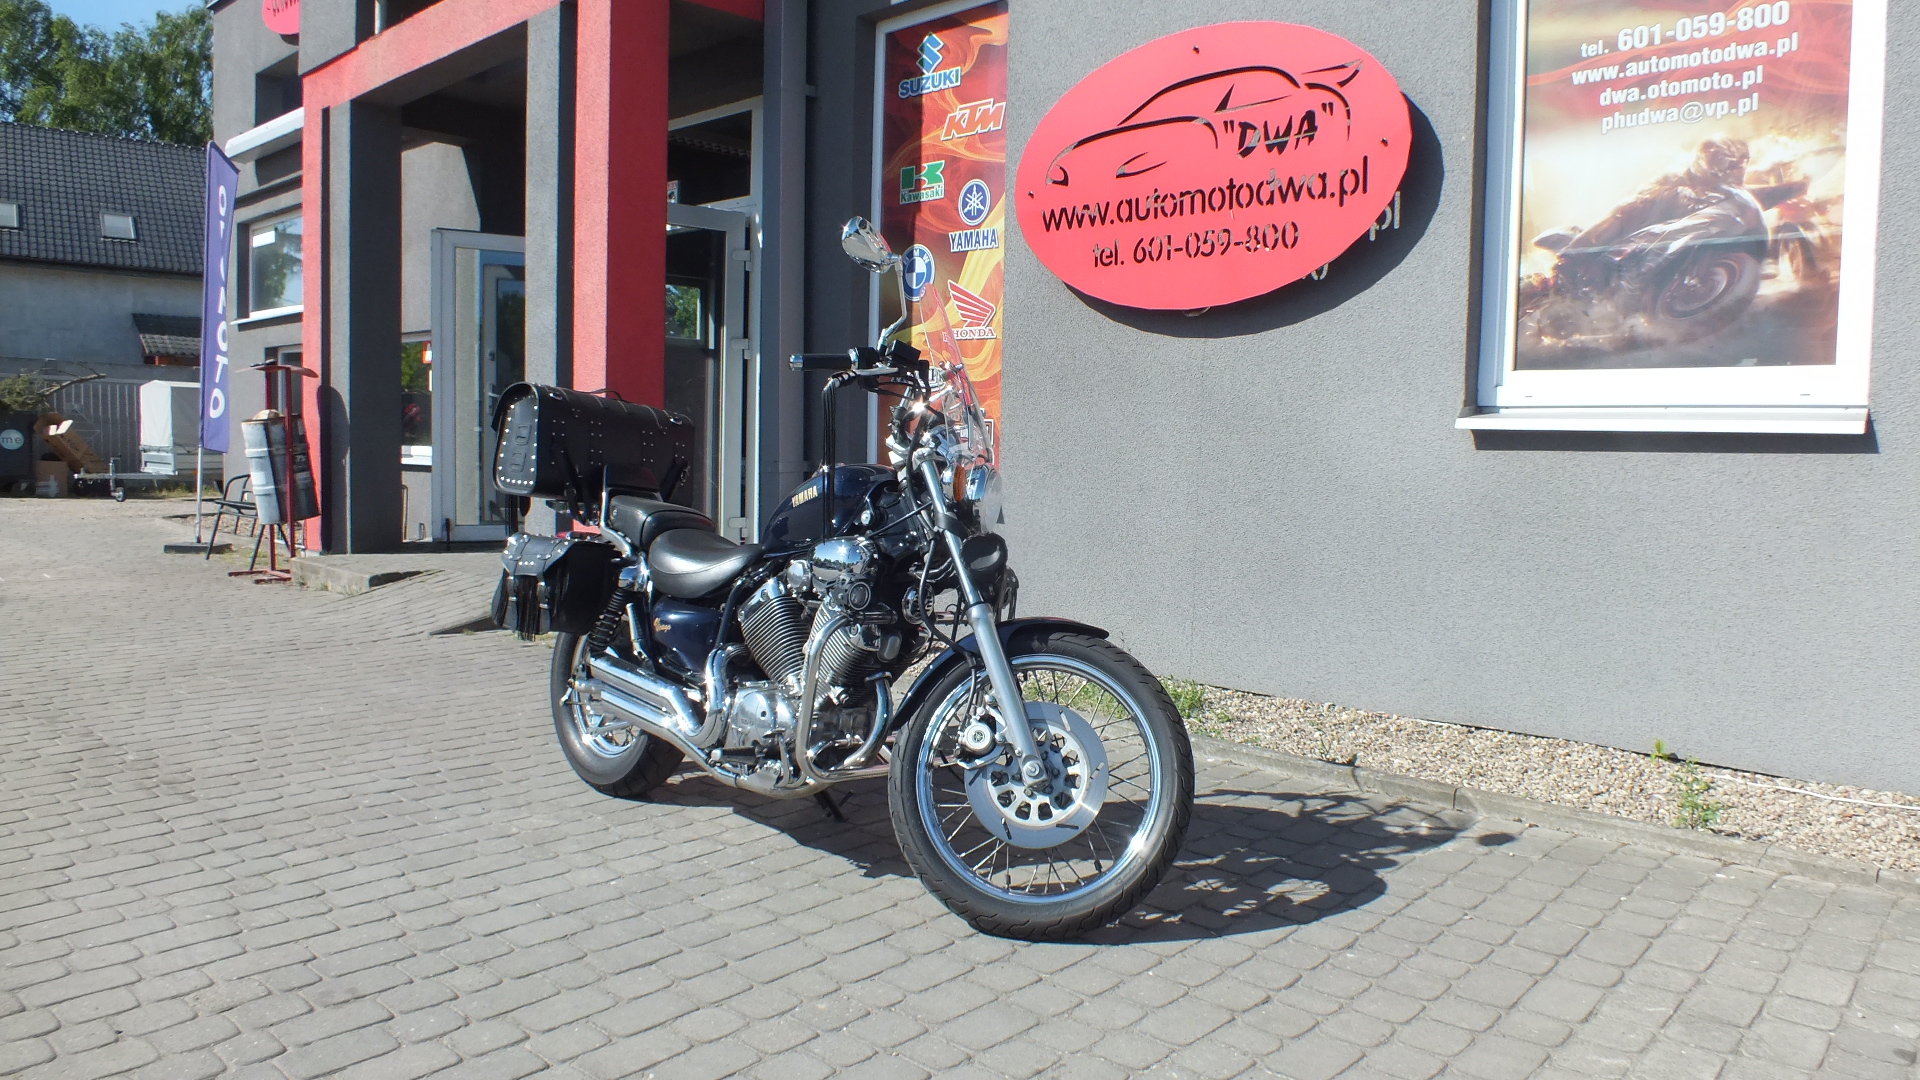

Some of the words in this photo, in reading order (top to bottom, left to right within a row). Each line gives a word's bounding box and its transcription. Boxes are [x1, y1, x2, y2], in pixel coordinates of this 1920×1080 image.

[1580, 39, 1610, 58] tel.
[1617, 0, 1790, 52] 601-059-800
[1571, 31, 1799, 86] www.automotodwa.pl
[899, 67, 960, 97] SUZUKI
[1599, 64, 1764, 107] dwa.otomoto.pl
[940, 98, 1007, 141] KTM
[1223, 102, 1334, 159] "DWA"
[1601, 92, 1760, 135] phudwa@vp.pl
[901, 183, 944, 203] Kawasaki
[1041, 155, 1369, 232] www.automotodwa.pl
[950, 228, 998, 252] YAMAHA
[1093, 238, 1125, 268] tel.
[1133, 221, 1300, 264] 601-059-800
[953, 328, 995, 338] HONDA
[791, 485, 819, 508] YAMAHA
